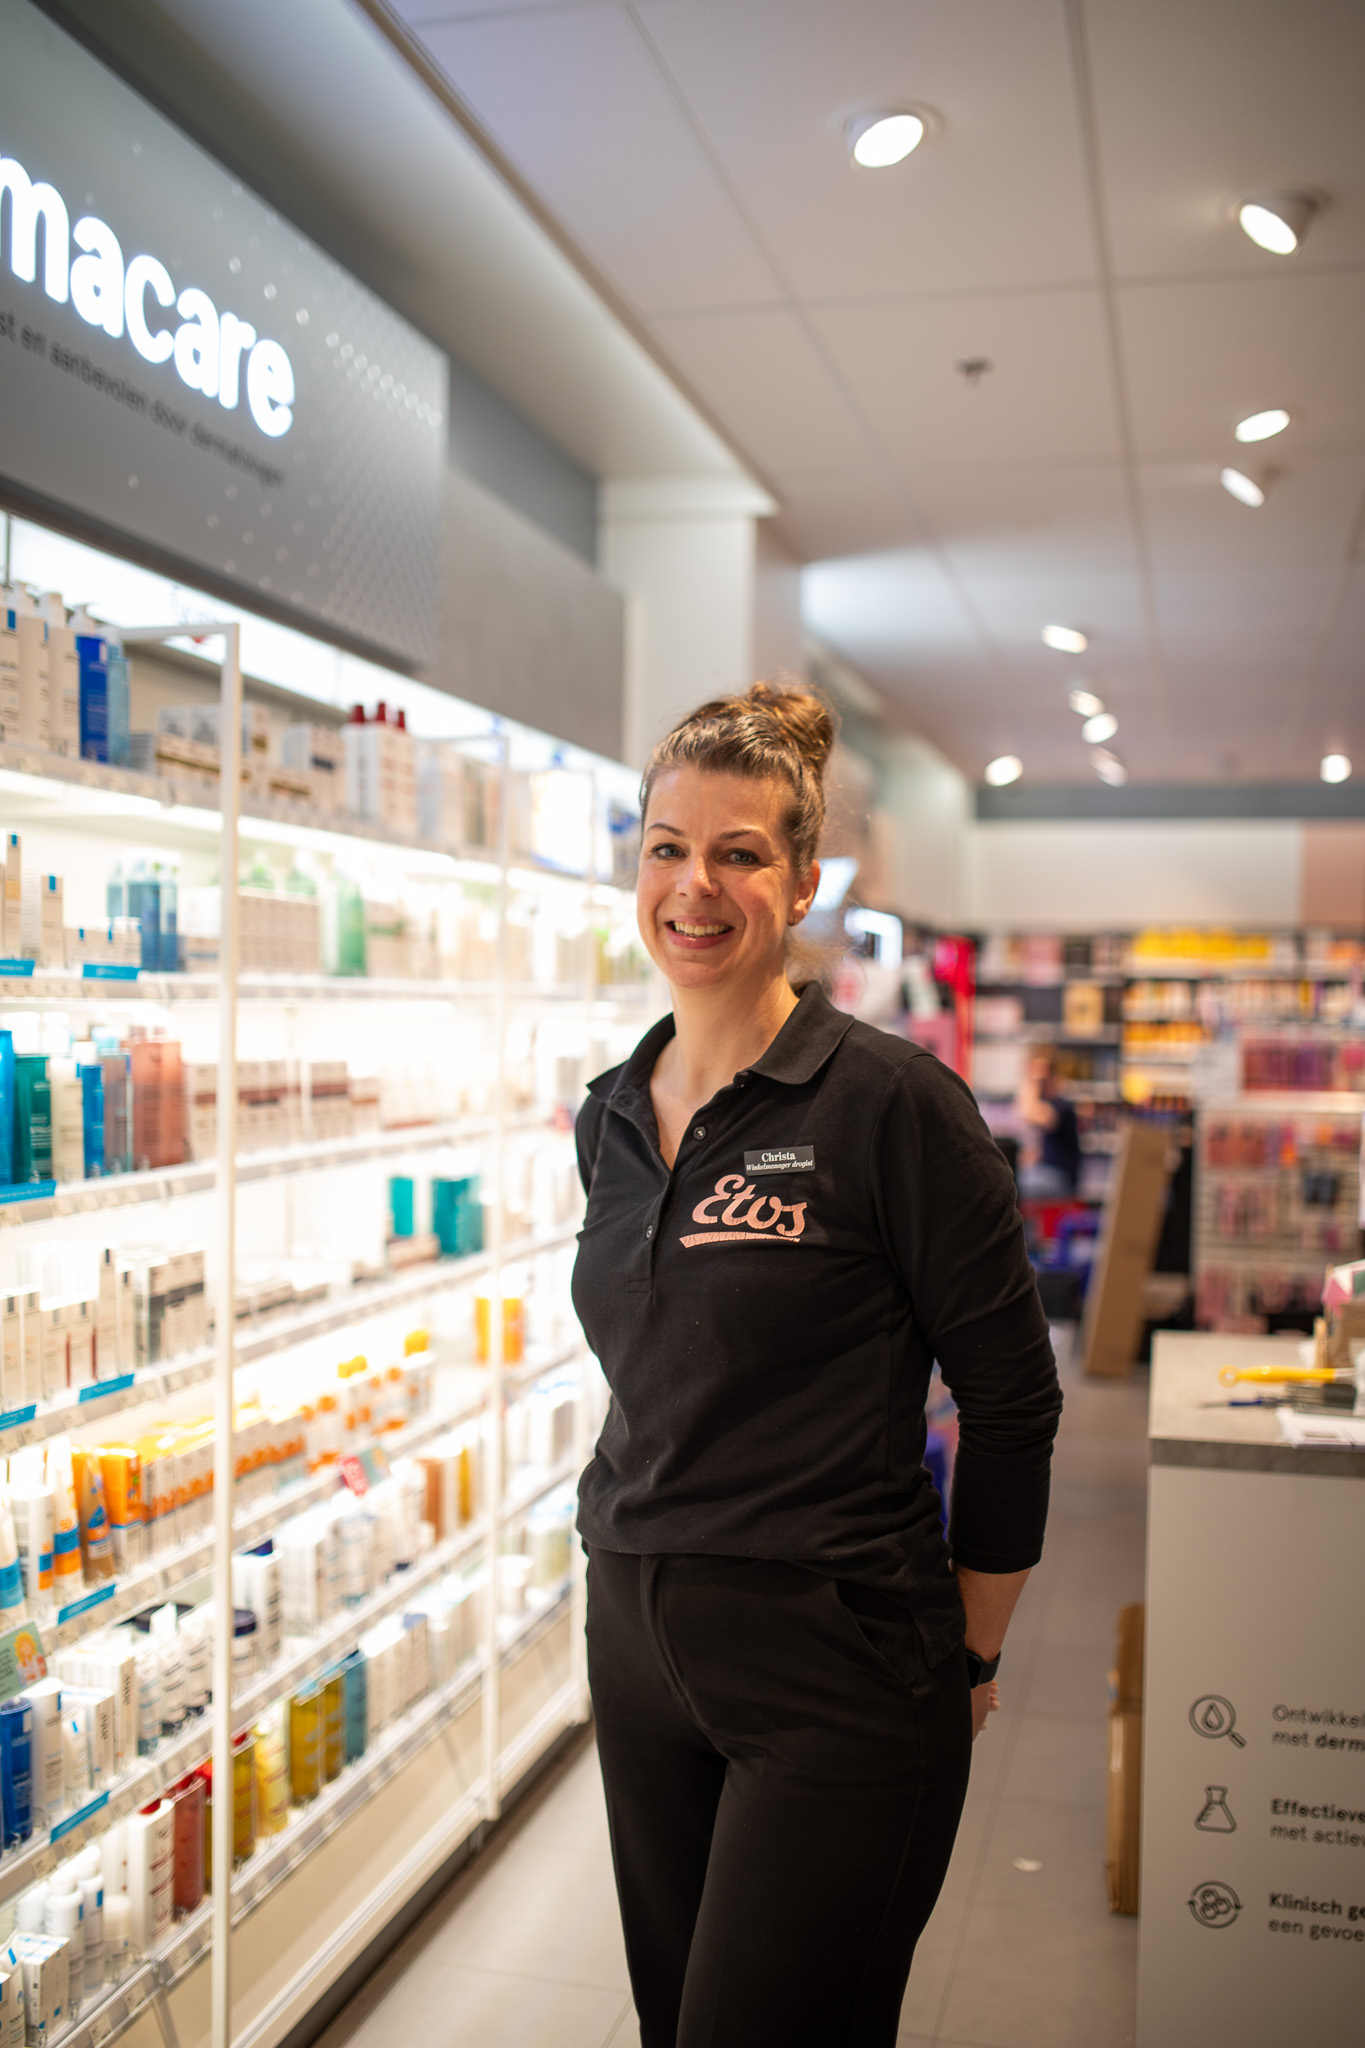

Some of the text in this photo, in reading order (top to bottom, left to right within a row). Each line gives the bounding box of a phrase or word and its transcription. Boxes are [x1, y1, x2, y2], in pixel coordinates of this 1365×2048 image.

[761, 1151, 796, 1162] Christa
[746, 1160, 814, 1171] Winkelmanager drogist
[692, 1174, 807, 1236] Etos
[1272, 1731, 1310, 1747] met
[1271, 1825, 1308, 1842] met
[1268, 1893, 1342, 1915] Klinisch
[1268, 1919, 1365, 1942] een gevoe
